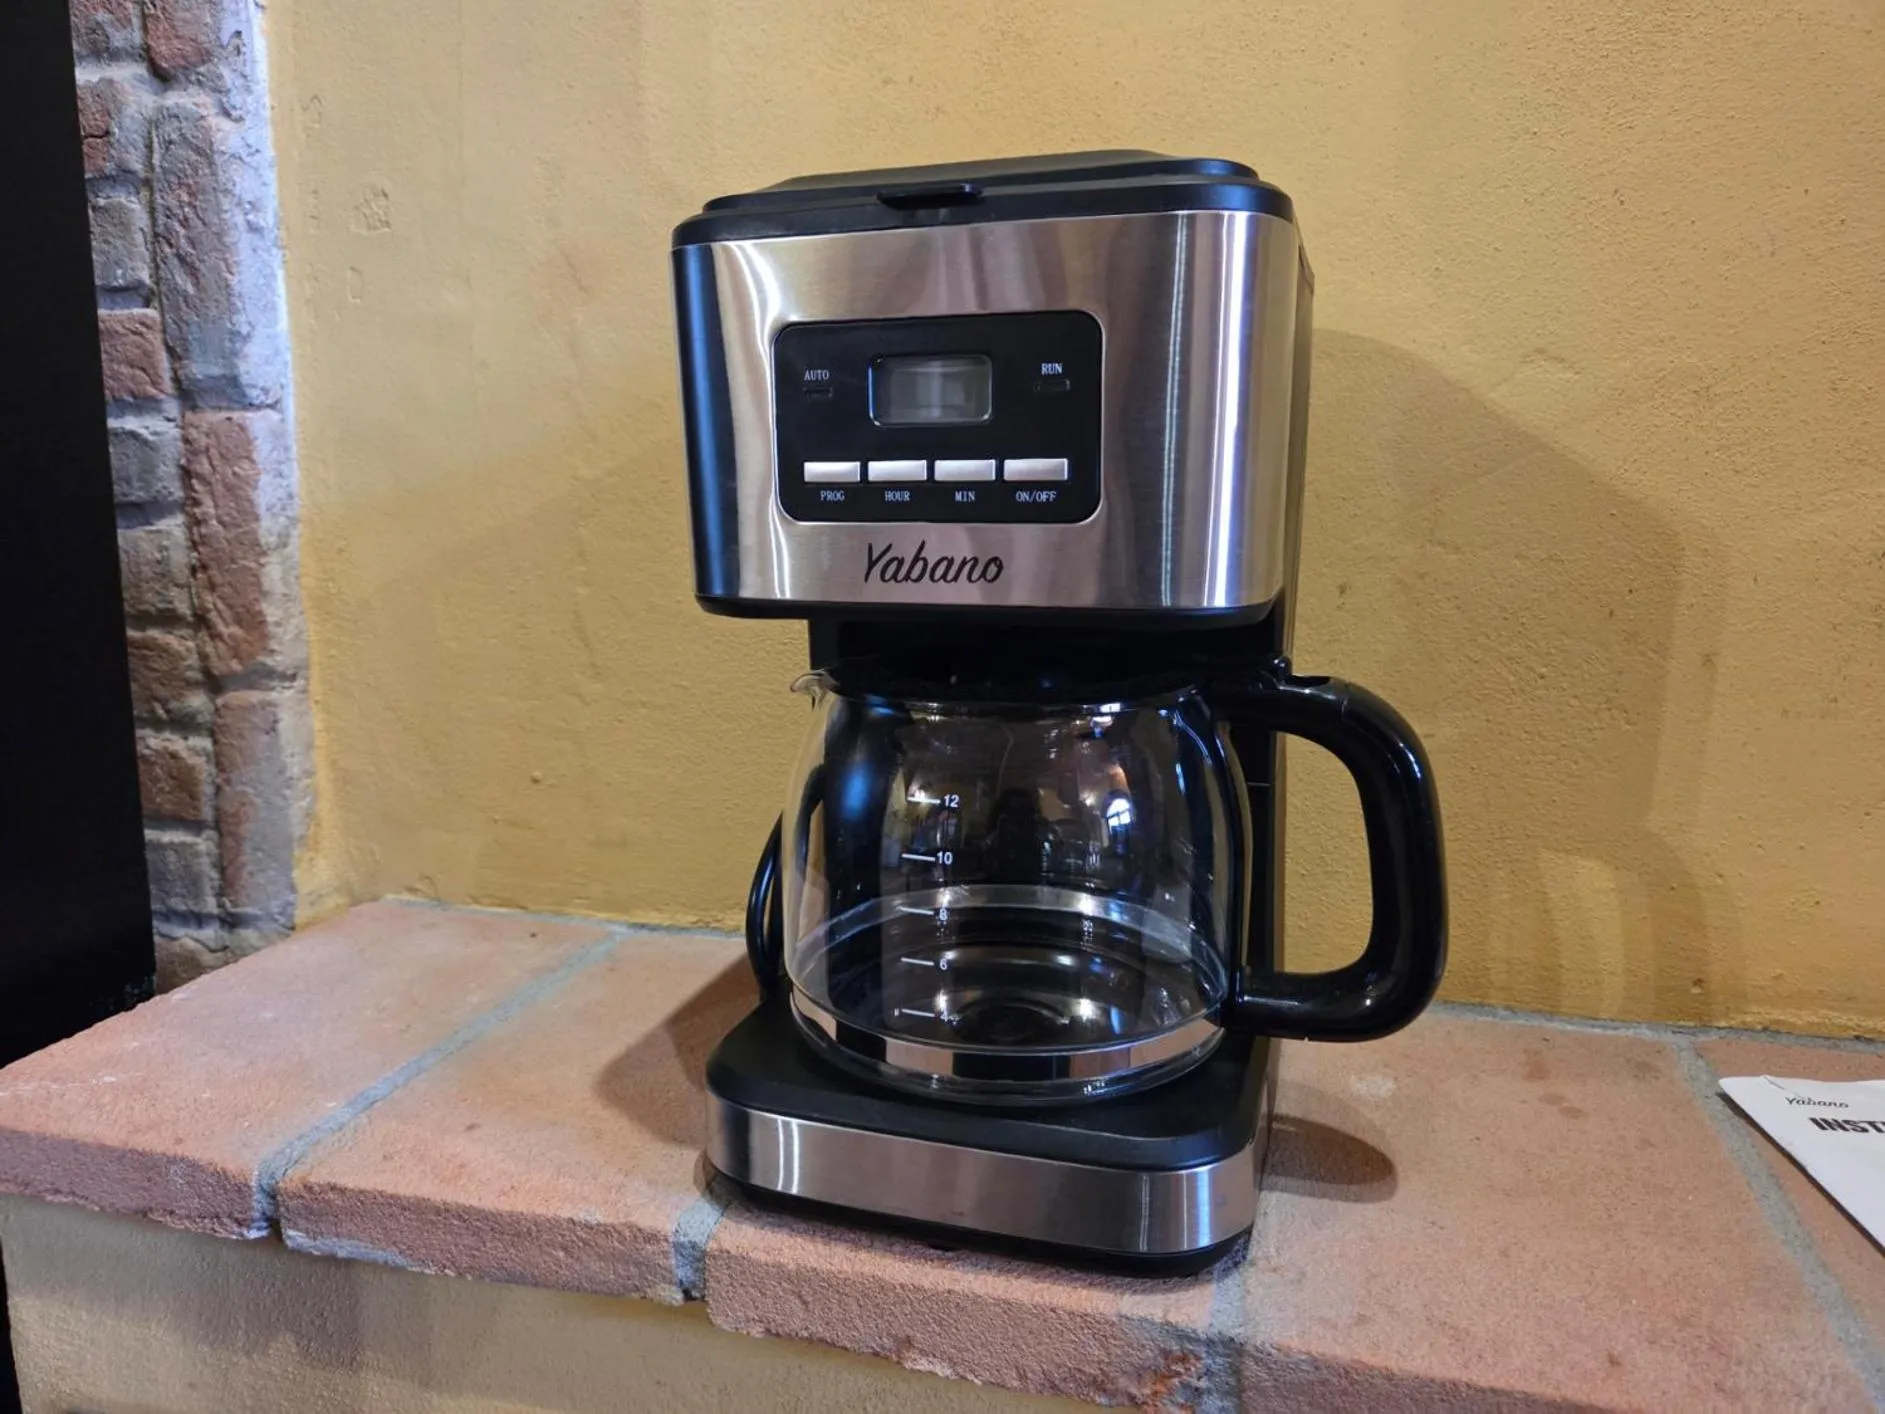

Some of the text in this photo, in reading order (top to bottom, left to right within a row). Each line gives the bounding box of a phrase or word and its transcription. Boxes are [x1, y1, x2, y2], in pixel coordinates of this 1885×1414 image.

[1041, 363, 1063, 375] RUN
[804, 370, 830, 381] AUTO
[820, 490, 845, 501] PROG
[884, 490, 911, 501] HOUR
[954, 491, 976, 501] MIN
[1015, 490, 1057, 502] ON/OFF
[864, 539, 1005, 585] Yabano
[944, 794, 960, 808] 12
[936, 852, 954, 865] 10
[938, 907, 949, 921] 8
[939, 959, 949, 970] 6
[1785, 1096, 1849, 1108] Yabano
[1808, 1117, 1885, 1133] INST
